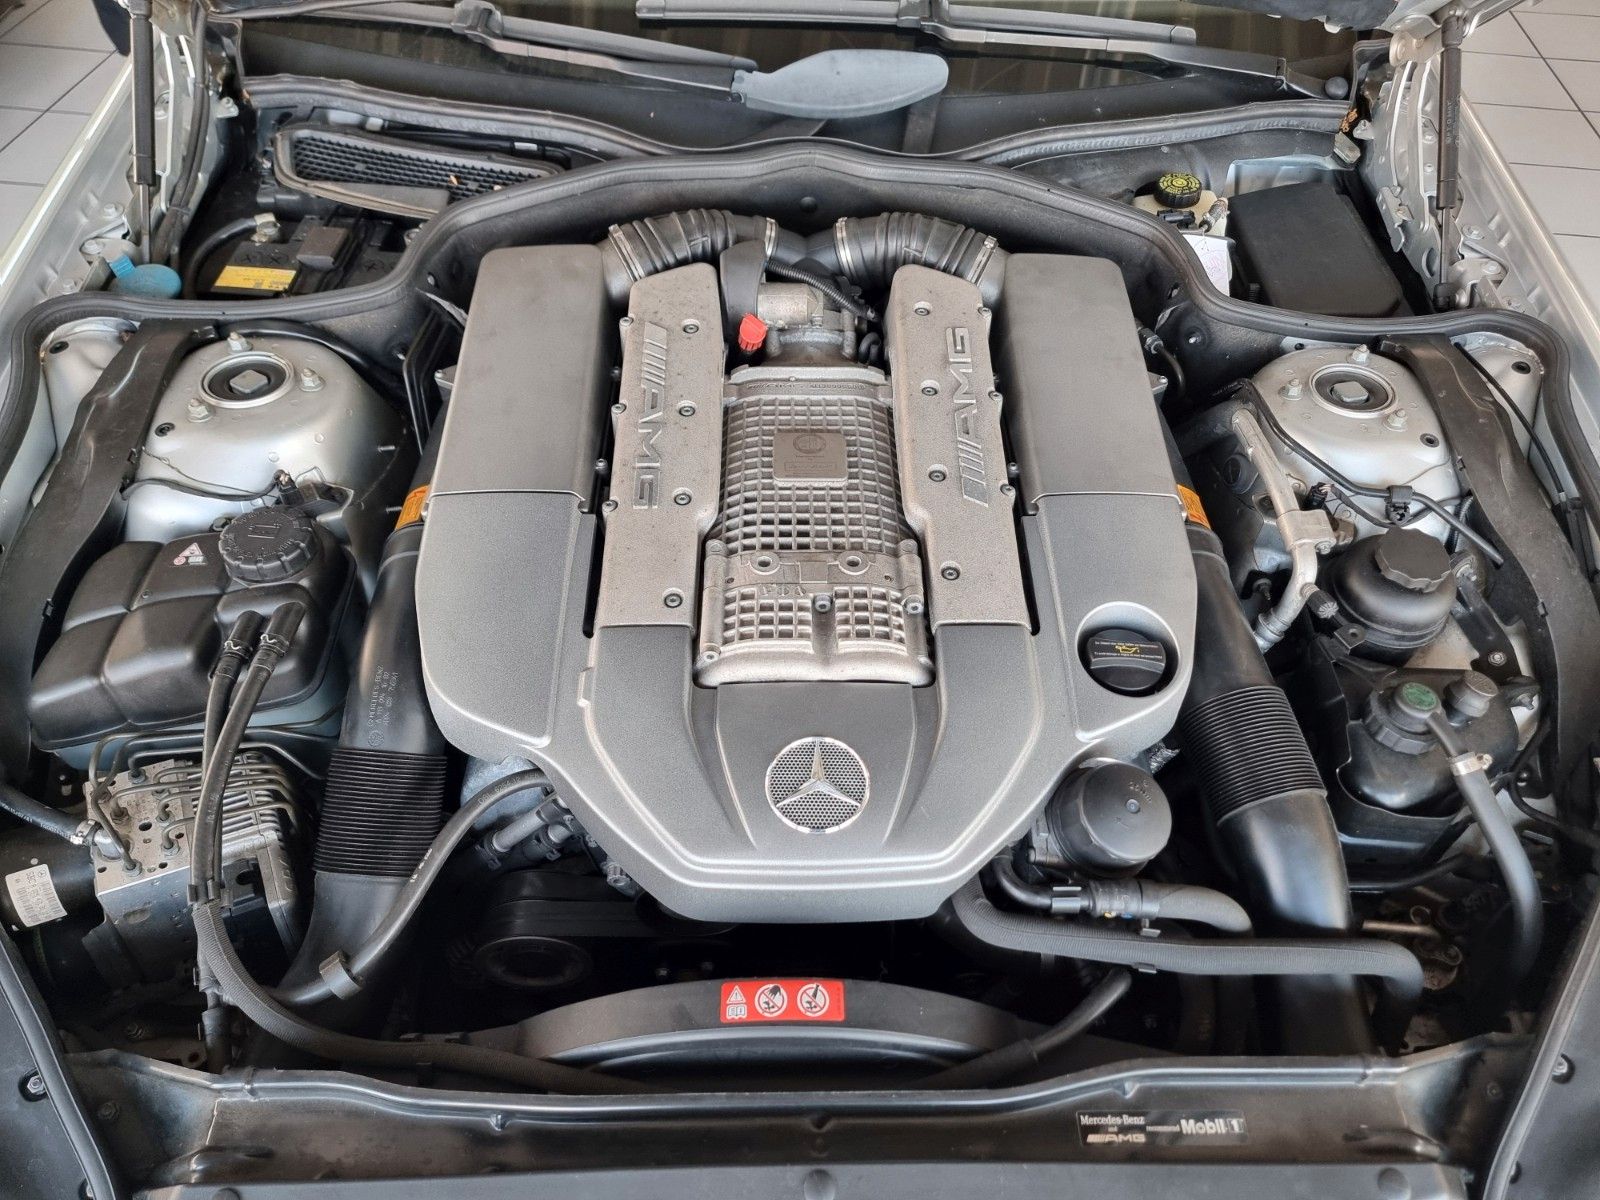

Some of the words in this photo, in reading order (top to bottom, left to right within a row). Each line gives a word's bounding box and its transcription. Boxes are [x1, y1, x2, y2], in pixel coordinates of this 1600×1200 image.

[945, 326, 982, 449] AMG
[632, 384, 666, 510] AMG
[1080, 1114, 1146, 1125] Mercedes-Benz
[1180, 1118, 1226, 1135] Mobil
[1103, 1133, 1147, 1143] AMG
